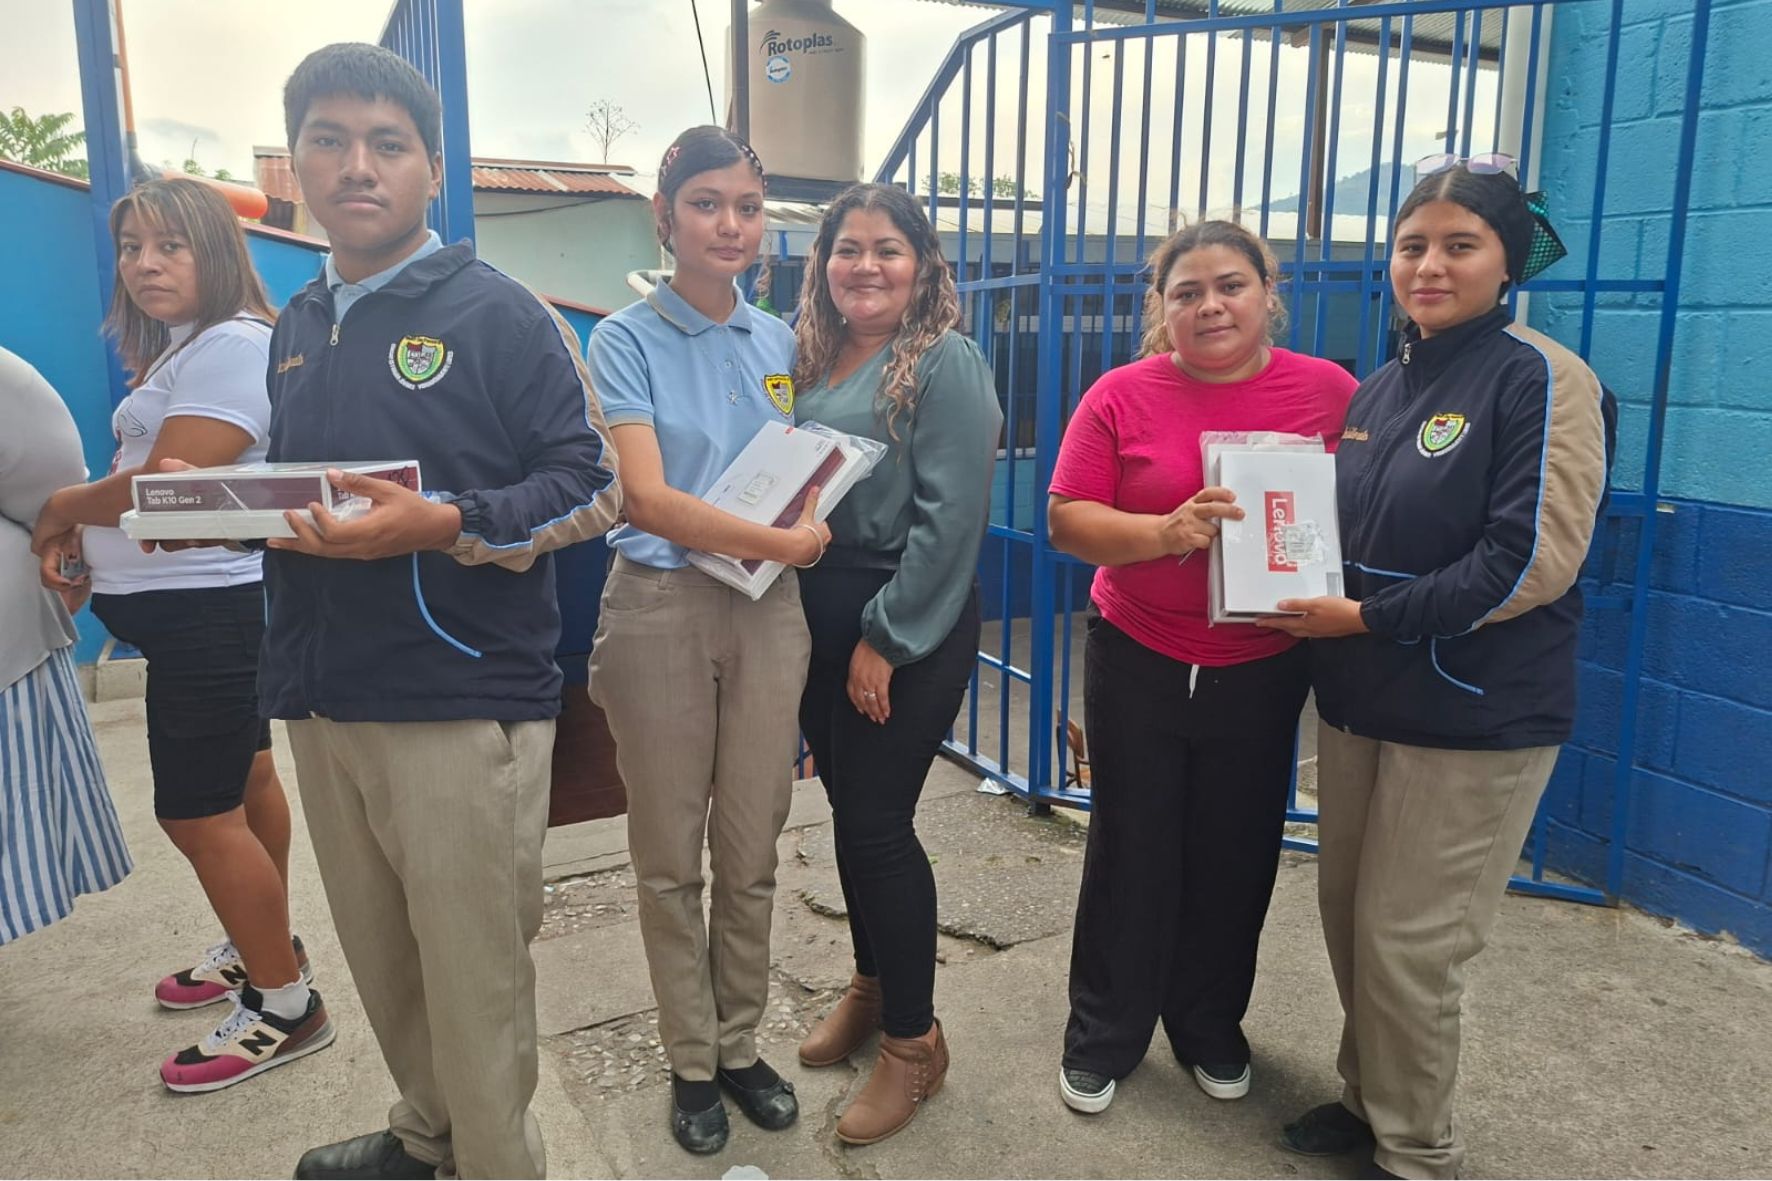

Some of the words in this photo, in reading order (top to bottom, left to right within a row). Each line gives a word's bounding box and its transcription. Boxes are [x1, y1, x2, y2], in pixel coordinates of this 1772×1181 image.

[767, 32, 833, 57] Rotoplas
[145, 488, 175, 496] Lenovo
[146, 496, 161, 505] Tab
[162, 496, 177, 505] K10
[178, 495, 195, 504] Gen
[195, 495, 202, 504] 2
[1271, 498, 1287, 566] Lenovo
[238, 1029, 278, 1056] N
